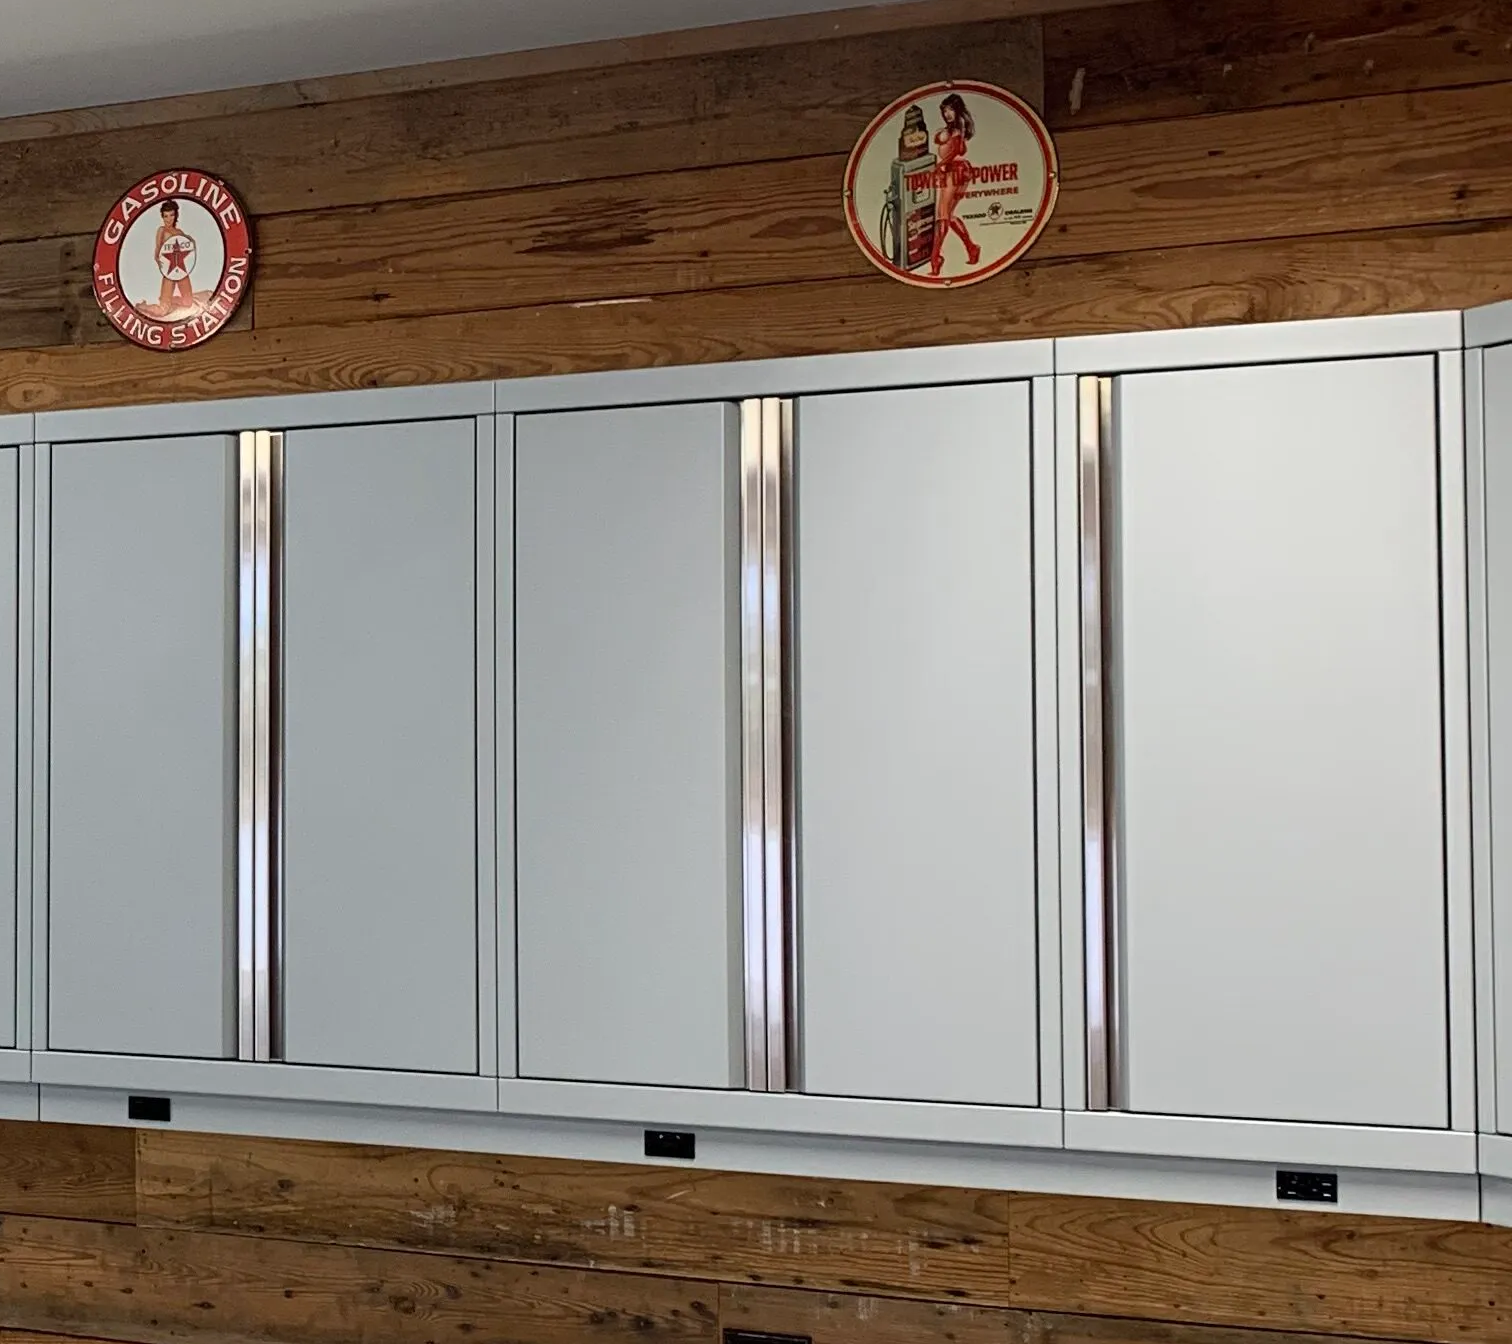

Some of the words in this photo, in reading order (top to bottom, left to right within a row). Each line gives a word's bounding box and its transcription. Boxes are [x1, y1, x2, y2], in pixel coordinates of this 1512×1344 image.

[103, 173, 241, 245] GASOLINE
[971, 163, 1018, 184] POWER
[98, 272, 164, 345] FILLING
[171, 257, 246, 345] STATION
